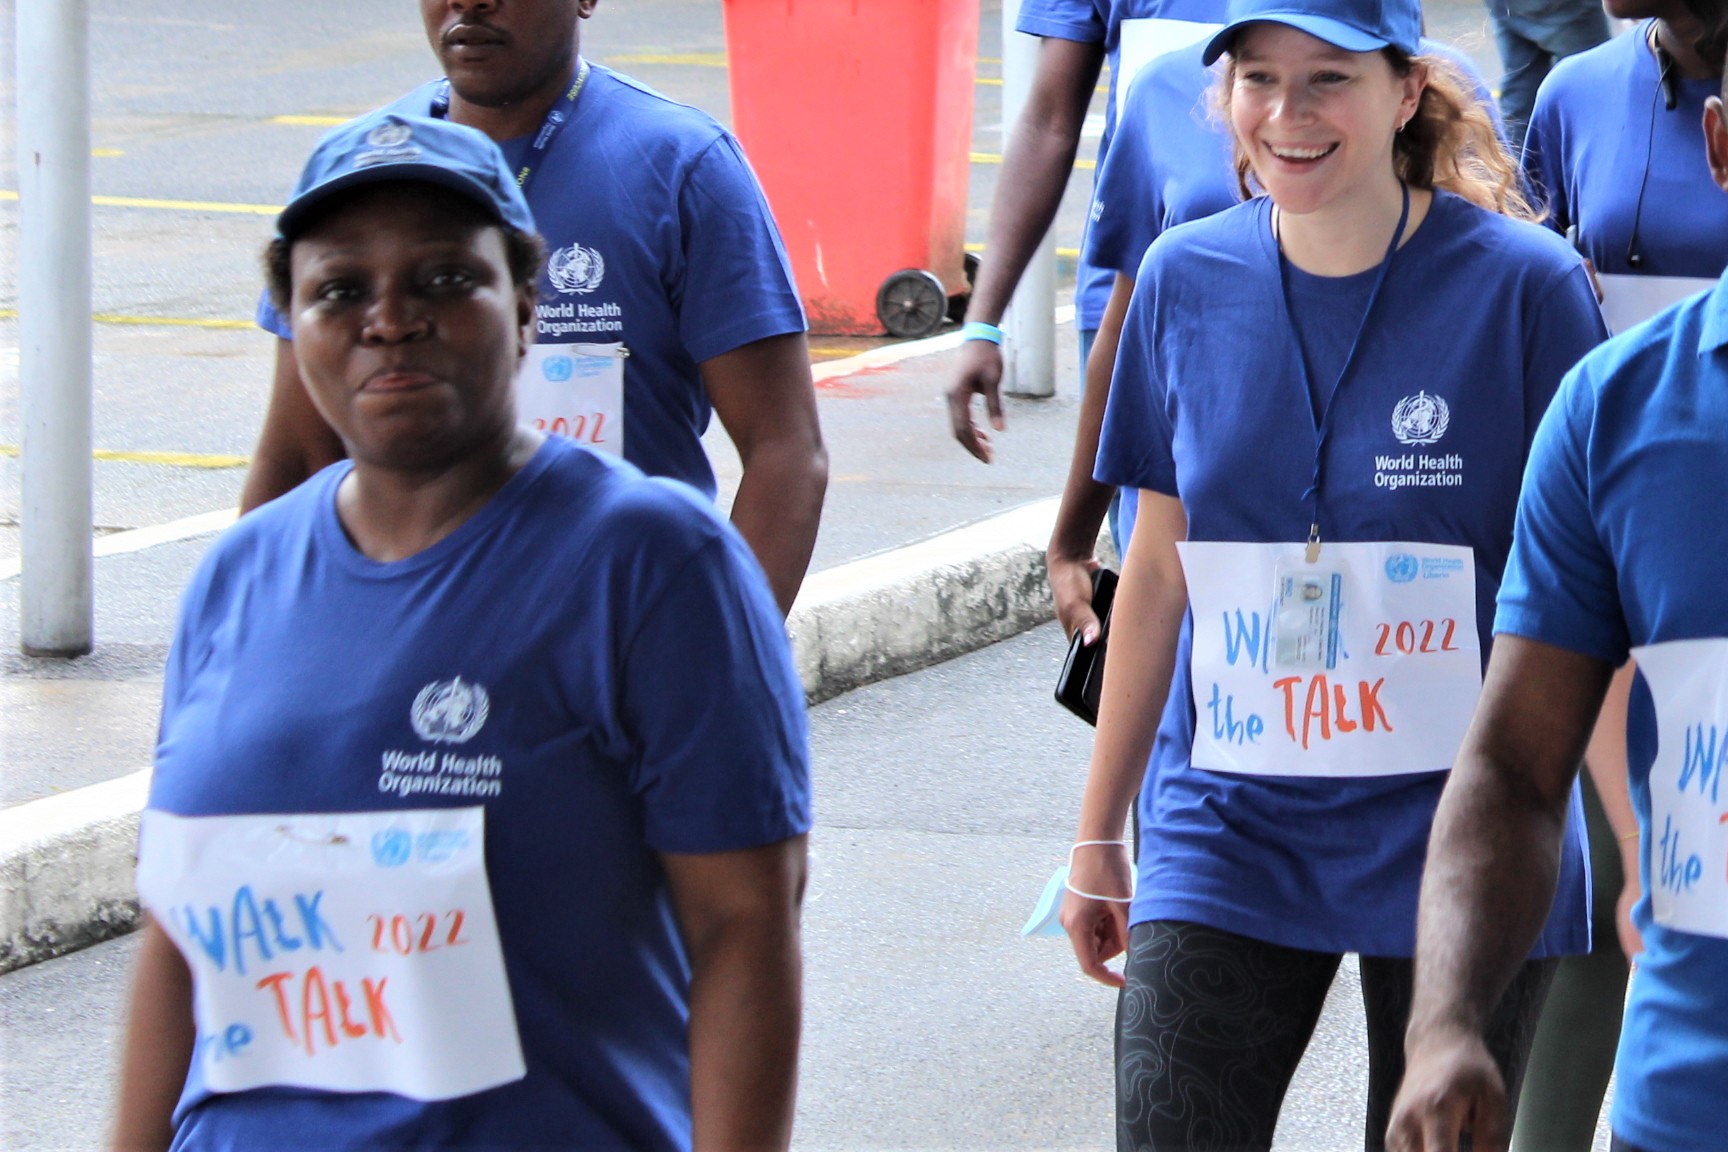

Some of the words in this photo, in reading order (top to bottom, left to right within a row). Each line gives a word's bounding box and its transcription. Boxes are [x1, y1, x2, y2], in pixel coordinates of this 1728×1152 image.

[535, 303, 574, 318] World
[578, 303, 622, 318] Health
[536, 319, 623, 336] Organization
[1375, 454, 1413, 470] World
[1419, 453, 1462, 470] Health
[1374, 470, 1462, 490] Organization
[1374, 617, 1459, 656] 2022
[1208, 681, 1264, 746] the
[1273, 674, 1393, 750] TALK
[382, 750, 437, 773] World
[441, 751, 502, 777] Health
[379, 770, 502, 797] Organization
[1660, 813, 1702, 896] the
[367, 909, 470, 957] 2022
[257, 966, 404, 1056] TALK
